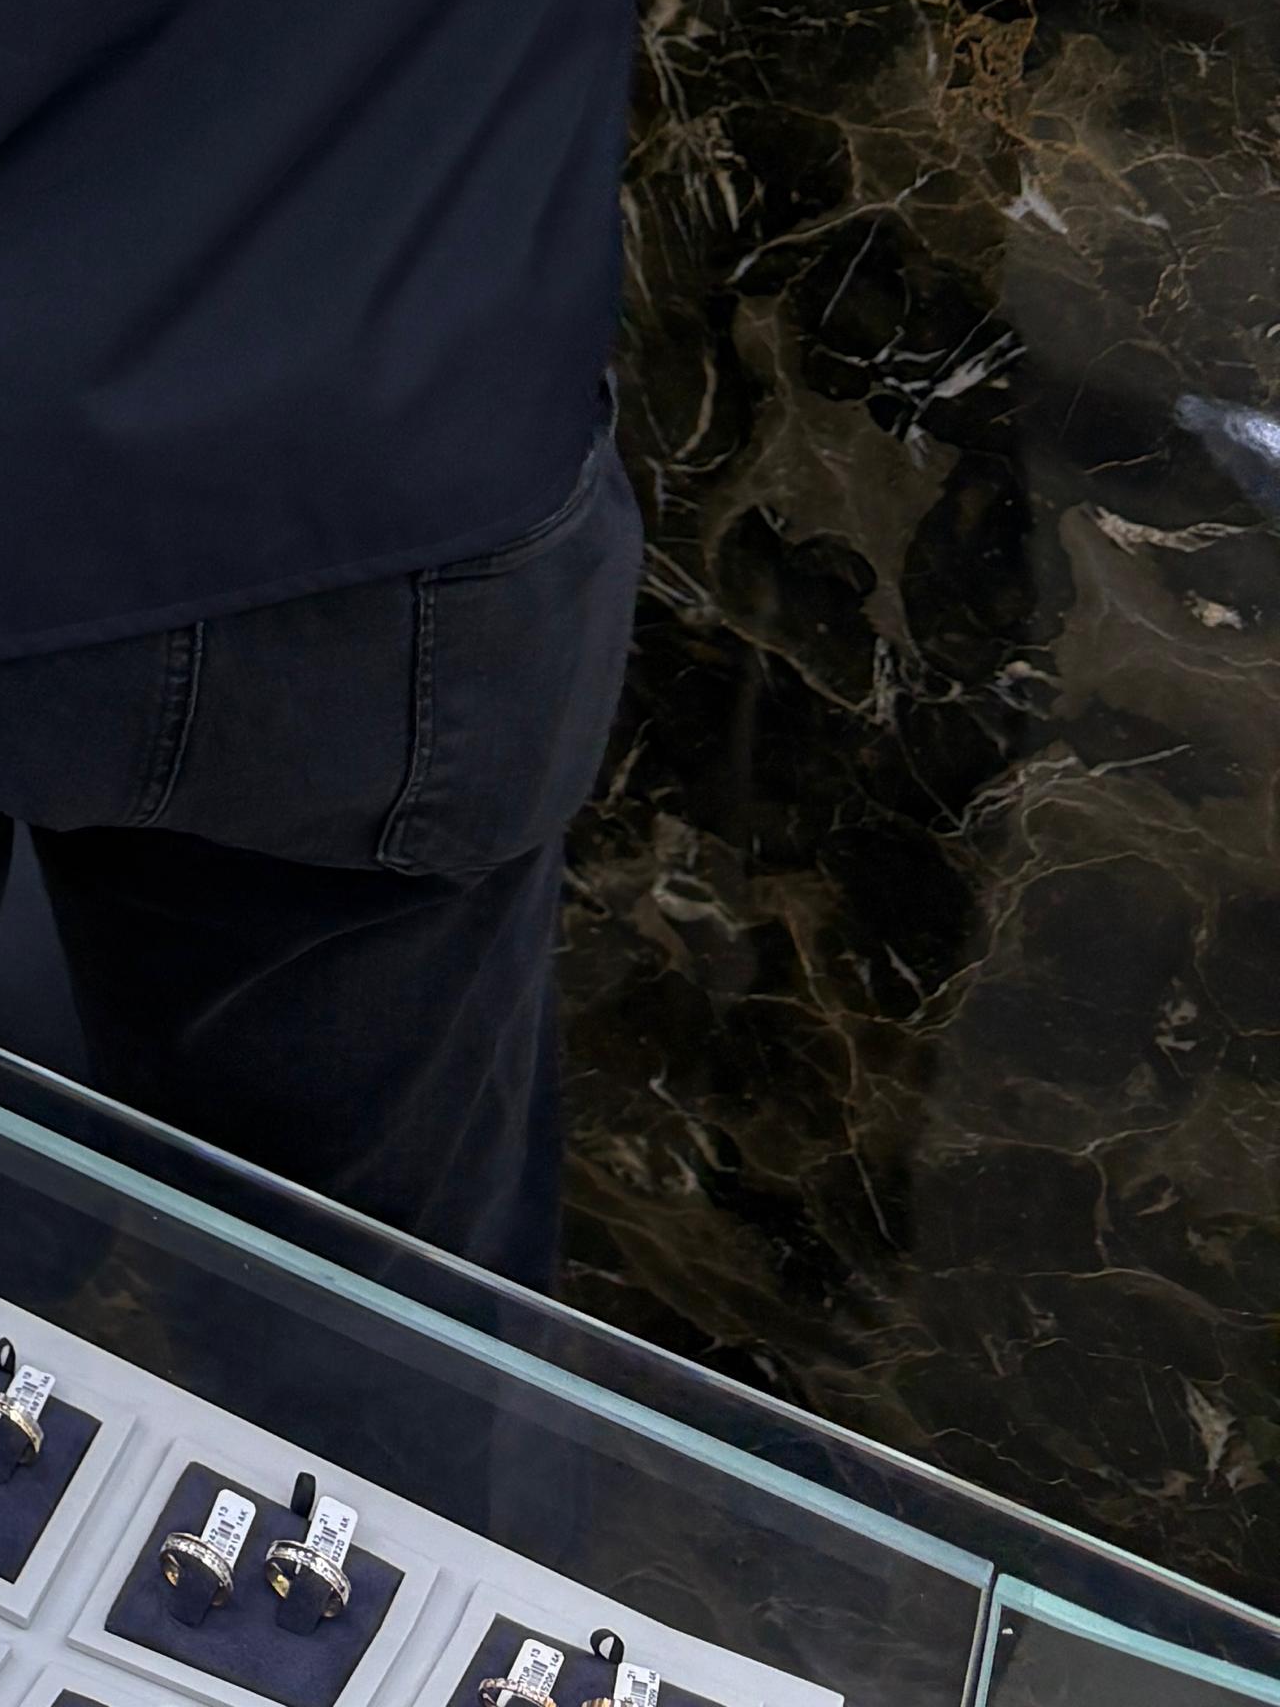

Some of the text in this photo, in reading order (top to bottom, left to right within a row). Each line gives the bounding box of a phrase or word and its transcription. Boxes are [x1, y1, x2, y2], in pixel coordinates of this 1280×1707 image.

[217, 1505, 229, 1518] 13
[234, 1508, 250, 1527] 14K
[318, 1512, 331, 1526] 21
[336, 1515, 352, 1534] 14K
[529, 1646, 541, 1659] 13
[548, 1651, 562, 1668] 14K
[626, 1669, 638, 1681] 21
[645, 1670, 660, 1685] 14K
